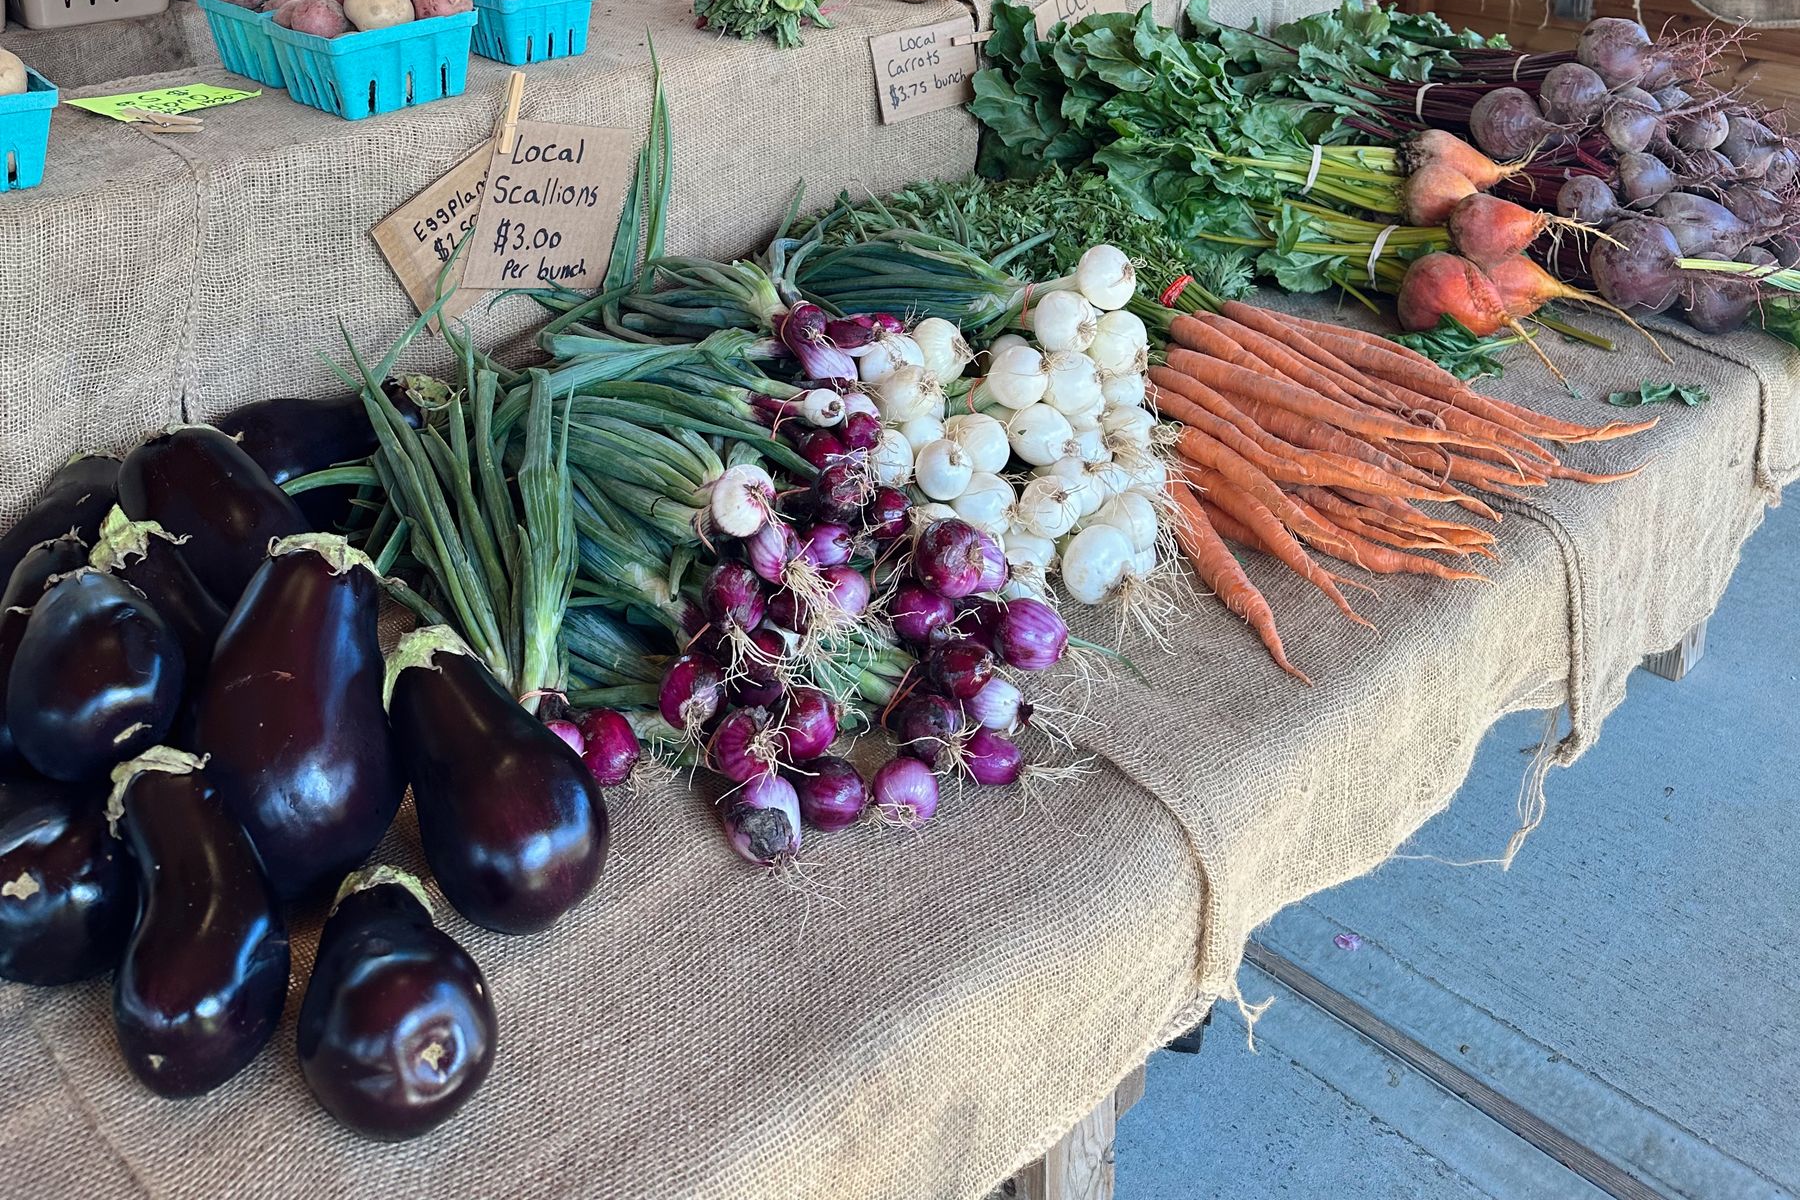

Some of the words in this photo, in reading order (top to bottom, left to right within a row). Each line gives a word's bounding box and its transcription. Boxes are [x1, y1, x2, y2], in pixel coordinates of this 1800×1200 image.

[887, 50, 940, 78] Carrots
[889, 81, 928, 110] $3.75
[934, 68, 967, 89] bunch
[511, 134, 585, 165] Local
[413, 171, 488, 243] Eggplan
[493, 175, 599, 208] Scallions
[493, 217, 562, 256] $3.00
[536, 256, 587, 282] bunch
